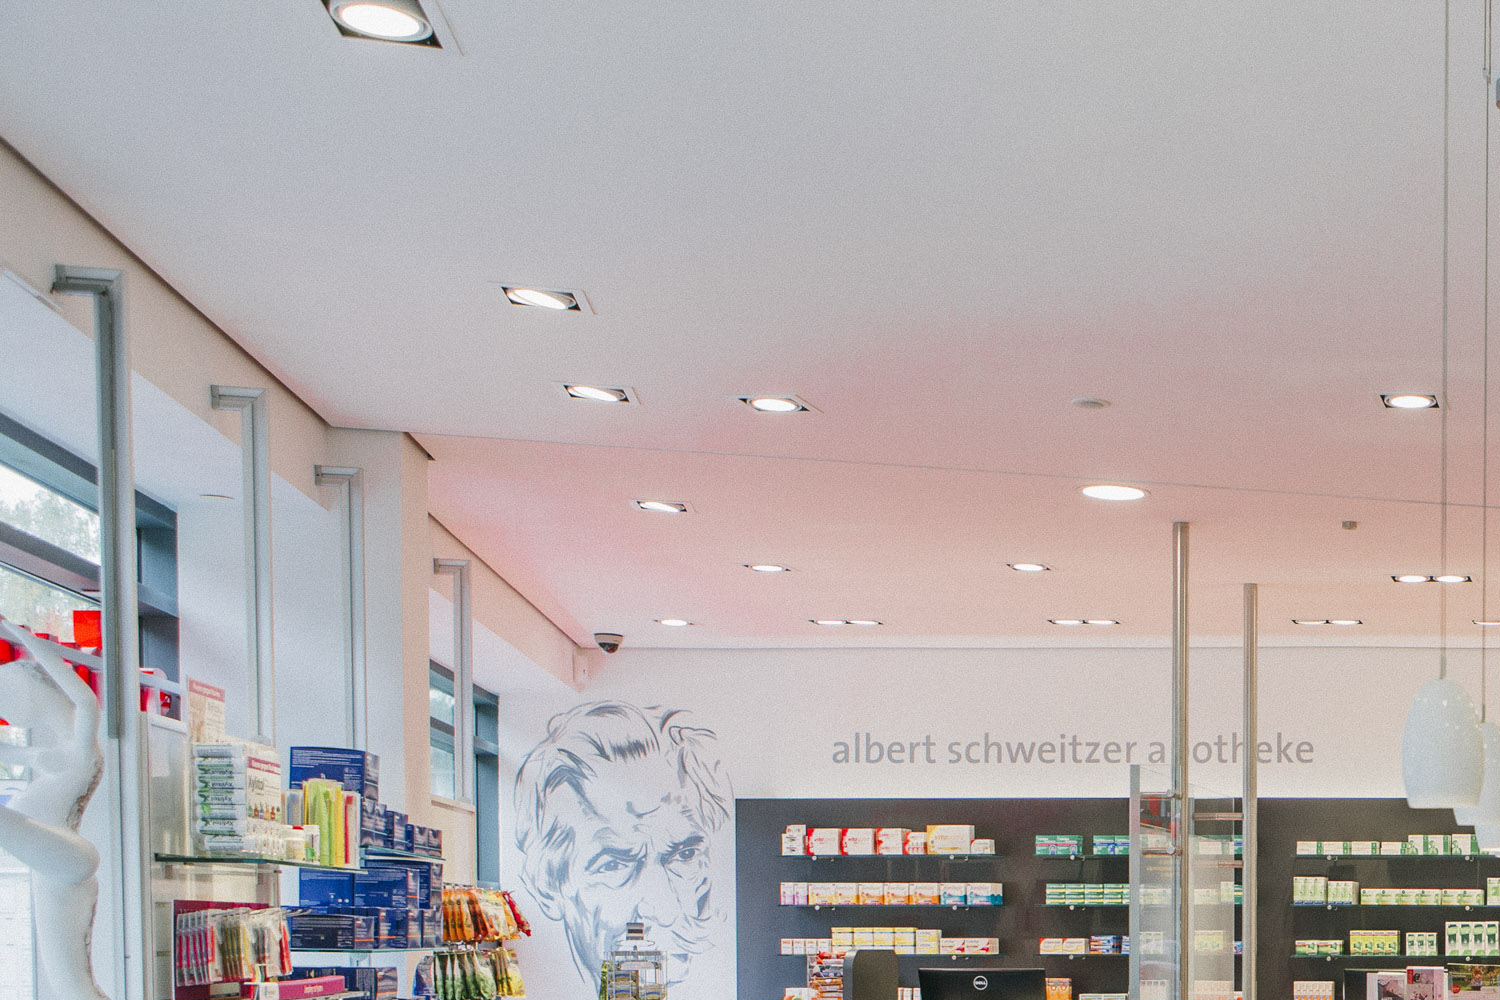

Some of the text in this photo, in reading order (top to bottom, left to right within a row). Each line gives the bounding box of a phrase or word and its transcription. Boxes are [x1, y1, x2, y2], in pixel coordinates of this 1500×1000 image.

[832, 732, 1314, 764] albert schweitzer aotheke
